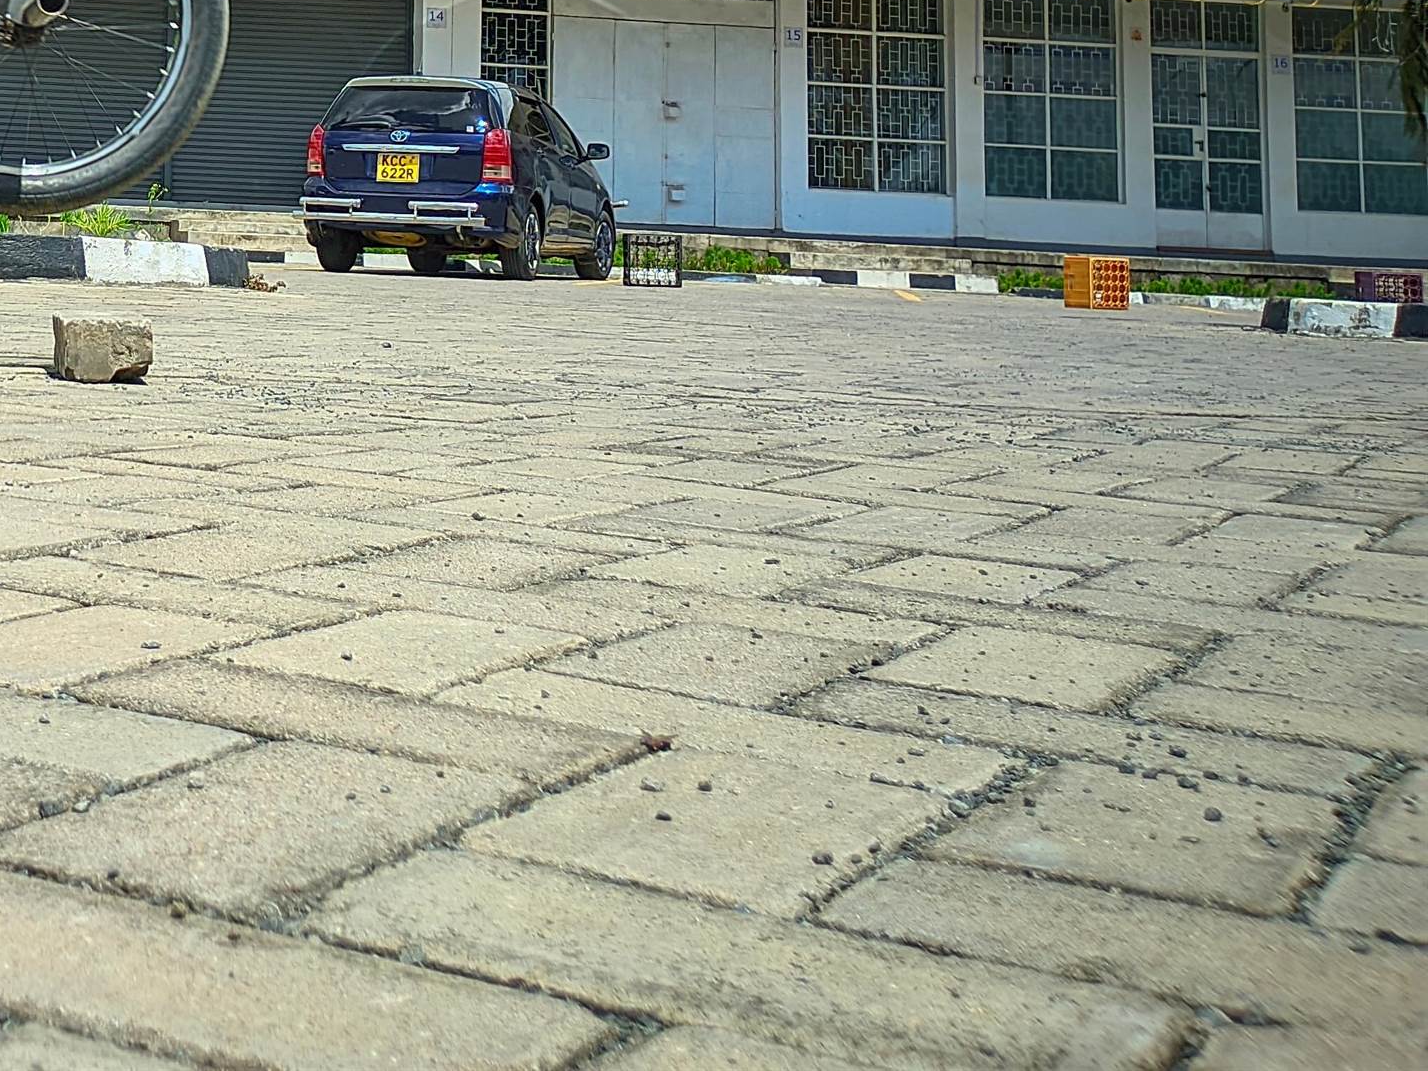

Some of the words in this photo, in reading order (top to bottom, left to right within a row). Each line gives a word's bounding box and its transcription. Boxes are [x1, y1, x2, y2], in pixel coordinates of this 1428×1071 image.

[429, 10, 444, 22] 14
[787, 29, 801, 41] 15
[1275, 57, 1288, 69] 16
[382, 154, 407, 167] KCC
[381, 167, 414, 180] 622R
